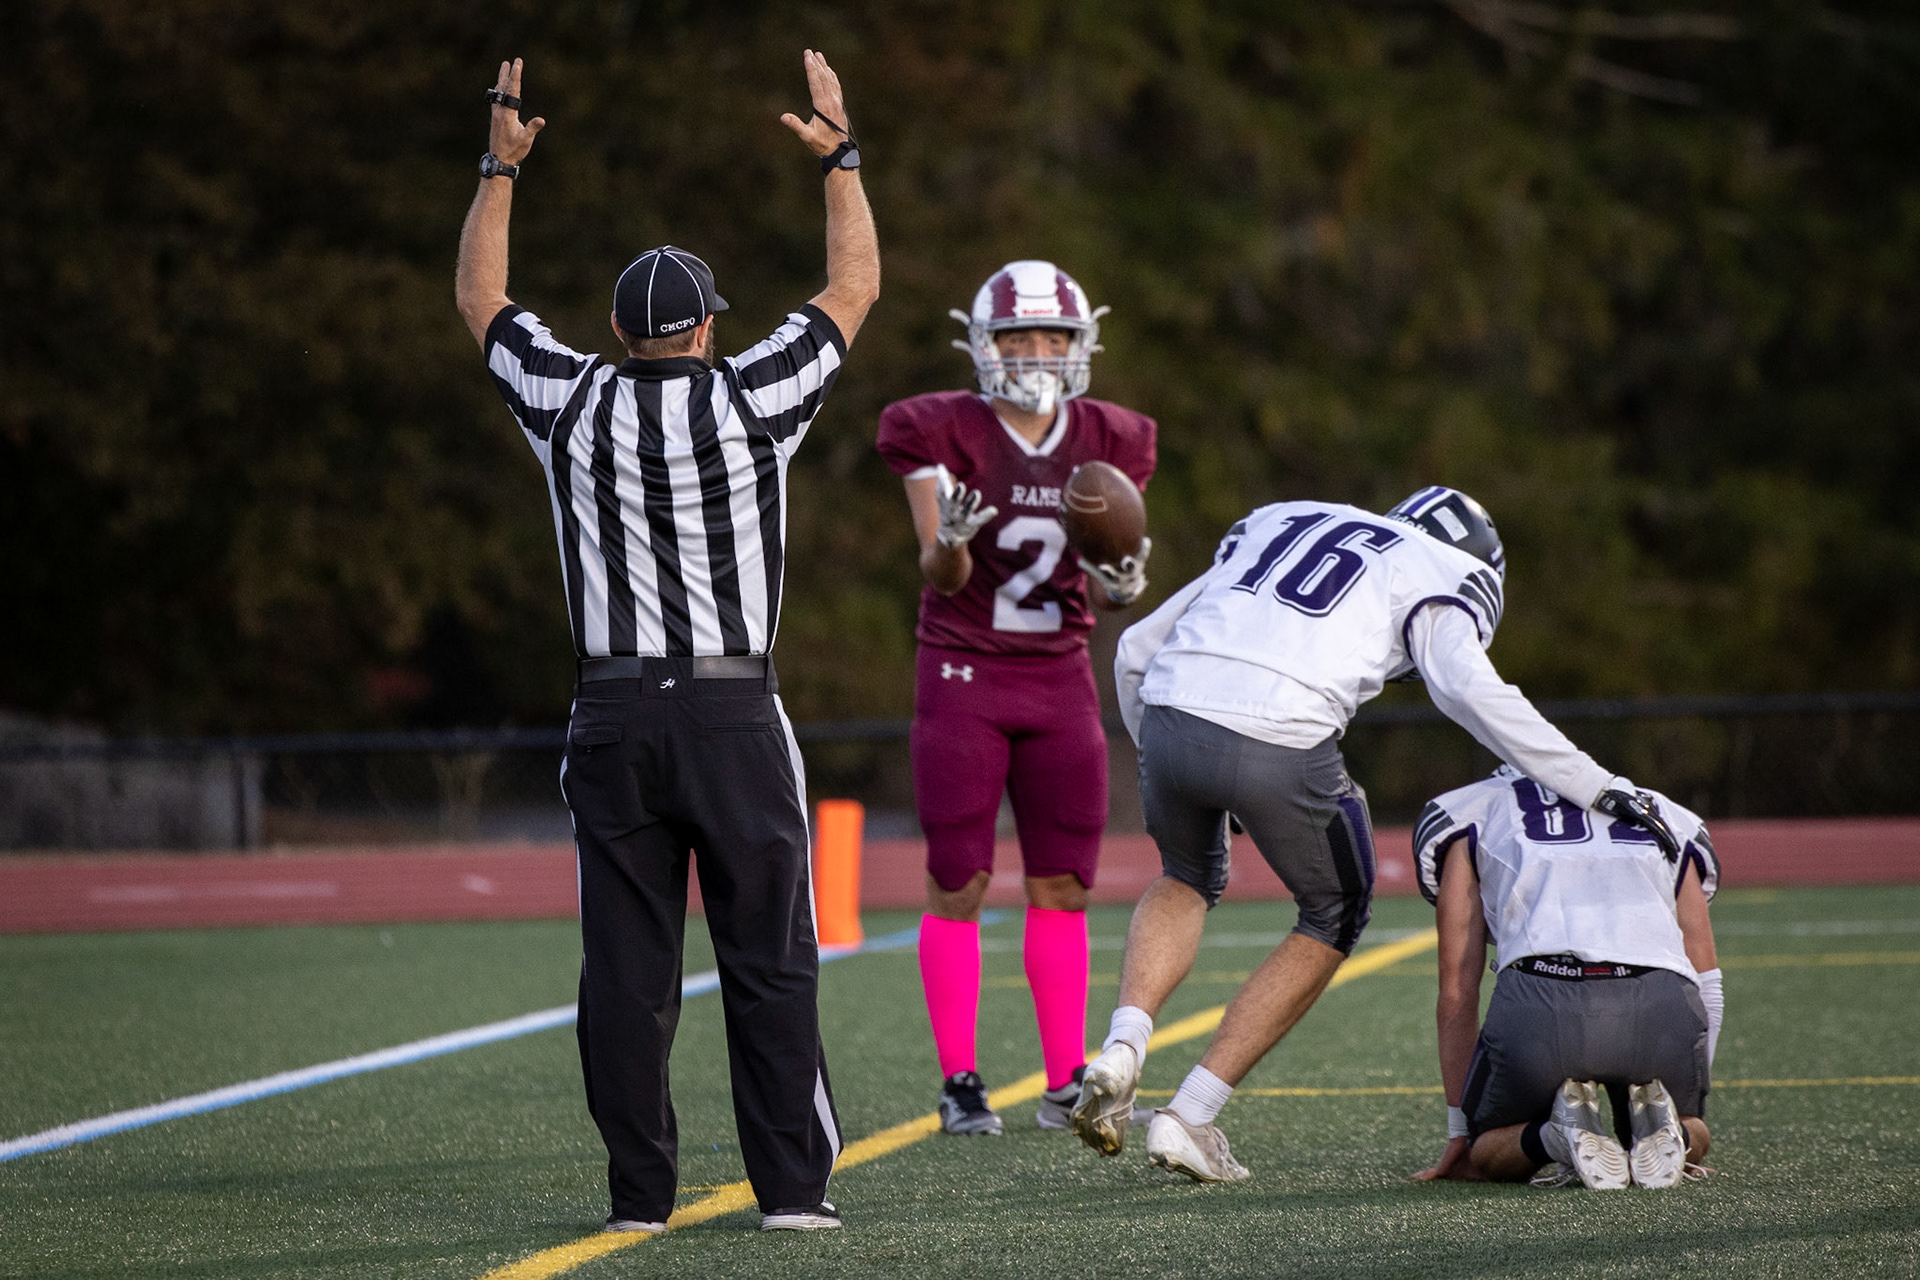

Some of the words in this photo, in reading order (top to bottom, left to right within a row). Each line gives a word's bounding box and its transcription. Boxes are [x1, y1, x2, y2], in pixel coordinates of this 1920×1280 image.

[1010, 484, 1062, 508] RAMS
[993, 515, 1068, 633] 2
[1230, 511, 1405, 618] 16
